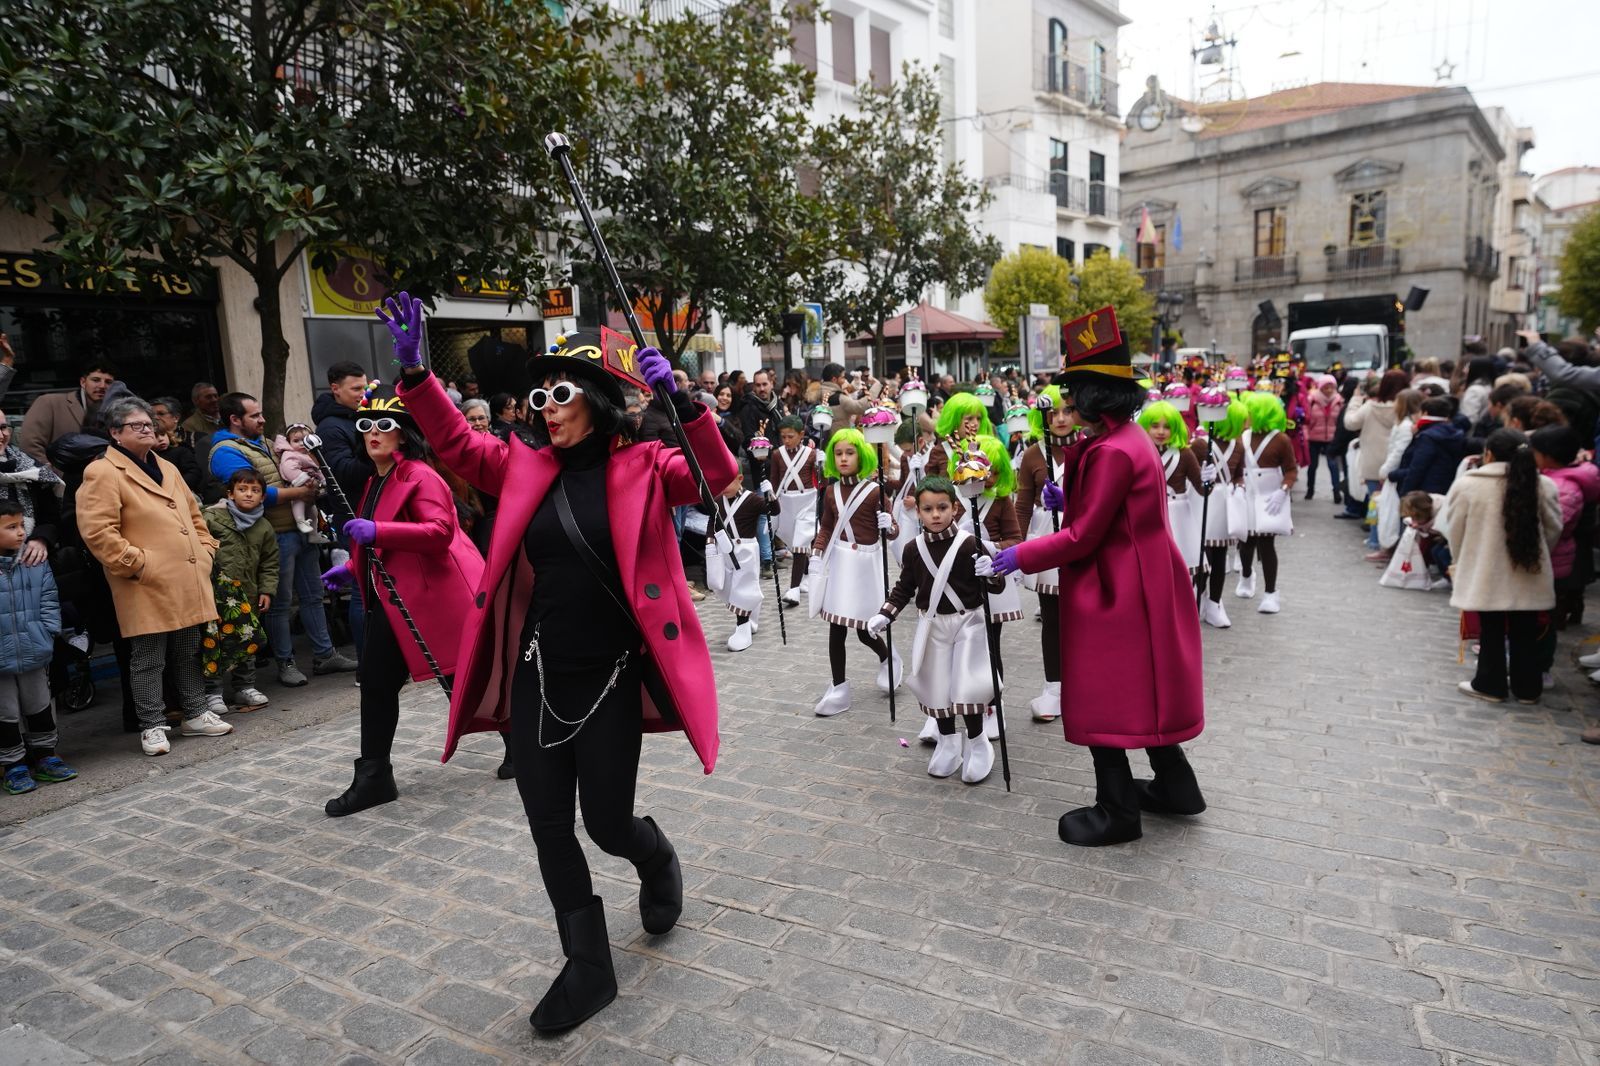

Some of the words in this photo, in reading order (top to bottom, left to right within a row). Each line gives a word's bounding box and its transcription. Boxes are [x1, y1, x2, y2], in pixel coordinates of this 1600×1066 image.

[352, 263, 369, 296] 8
[543, 305, 572, 317] TABACOS
[1077, 314, 1098, 351] W
[616, 344, 638, 373] W
